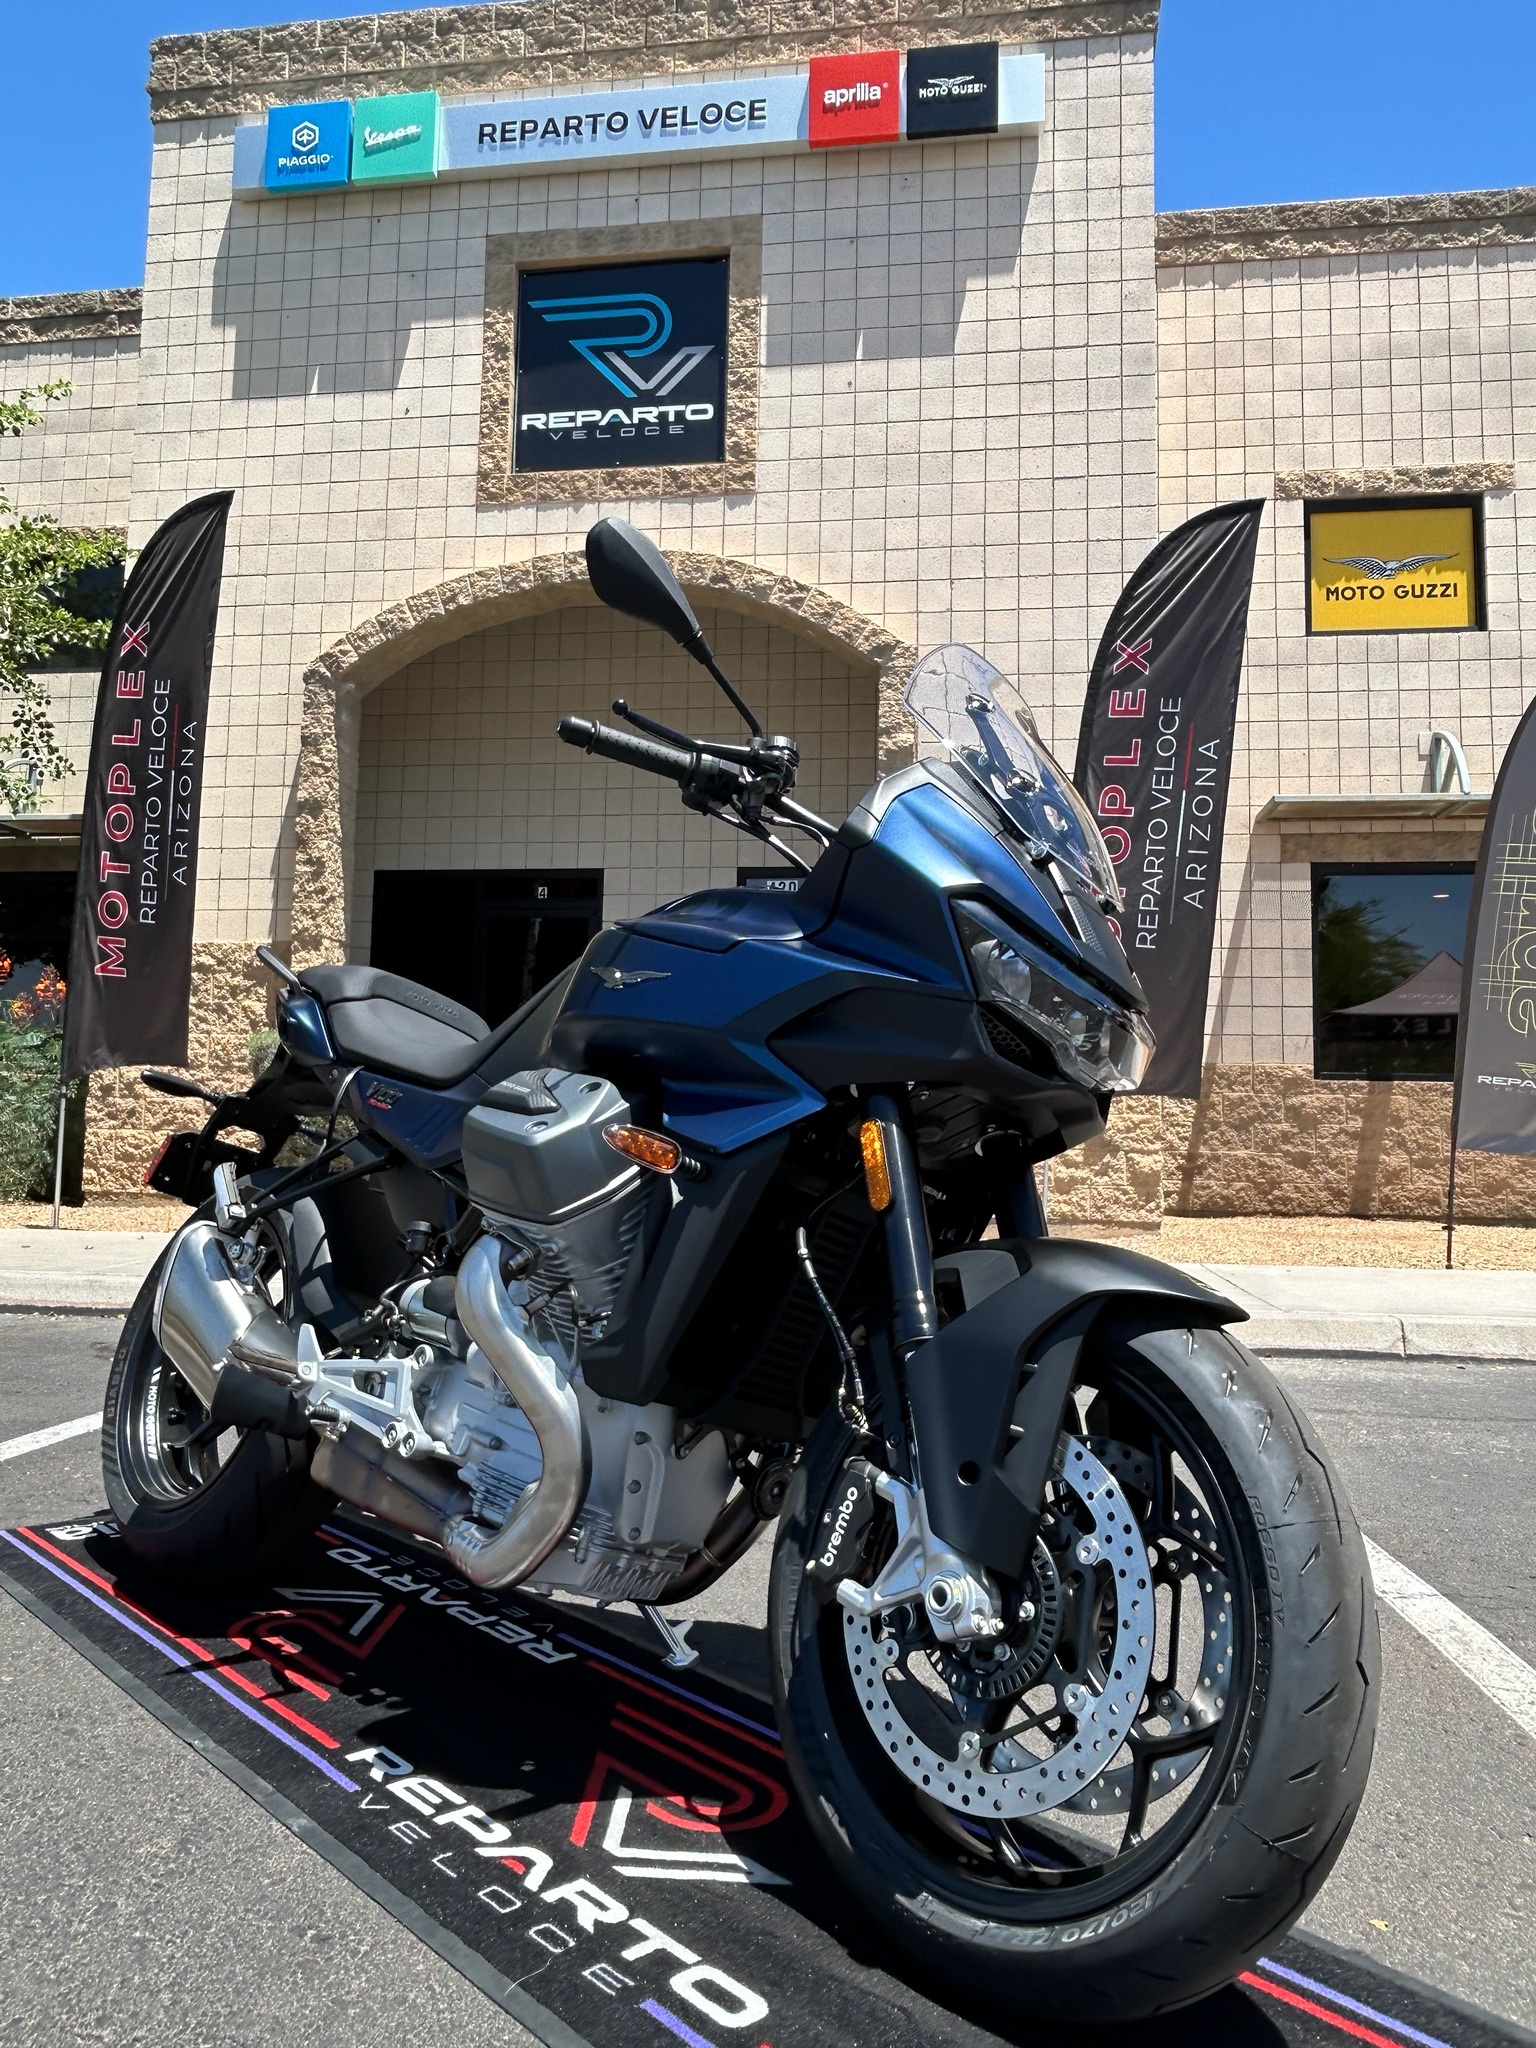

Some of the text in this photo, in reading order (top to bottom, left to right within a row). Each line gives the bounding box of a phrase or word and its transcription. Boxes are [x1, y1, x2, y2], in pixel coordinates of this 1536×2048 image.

[478, 98, 767, 145] REPARTO VELOCE
[823, 82, 882, 106] aprilia
[919, 86, 949, 98] MOTO
[278, 153, 331, 168] PIAGGIO
[364, 124, 422, 147] Vespa
[520, 403, 714, 431] REPARTO
[550, 425, 685, 441] VELOCE
[1325, 583, 1458, 601] MOTO GUZZI
[94, 621, 150, 978] MOTOPLEX
[139, 679, 171, 924] REPARTO VELOCE
[173, 721, 197, 886] ARIZONA
[1098, 638, 1153, 941] OPLEX
[1136, 697, 1182, 949] REPARTO VELOCE
[1183, 739, 1220, 909] ARIZONA
[820, 1487, 858, 1567] brembo
[327, 1548, 577, 1664] REPARTO
[389, 1554, 554, 1633] VELOCE
[345, 1746, 769, 2028] REPARTO
[359, 1793, 635, 1995] VELOCE
[1061, 1890, 1154, 1943] 120/70
